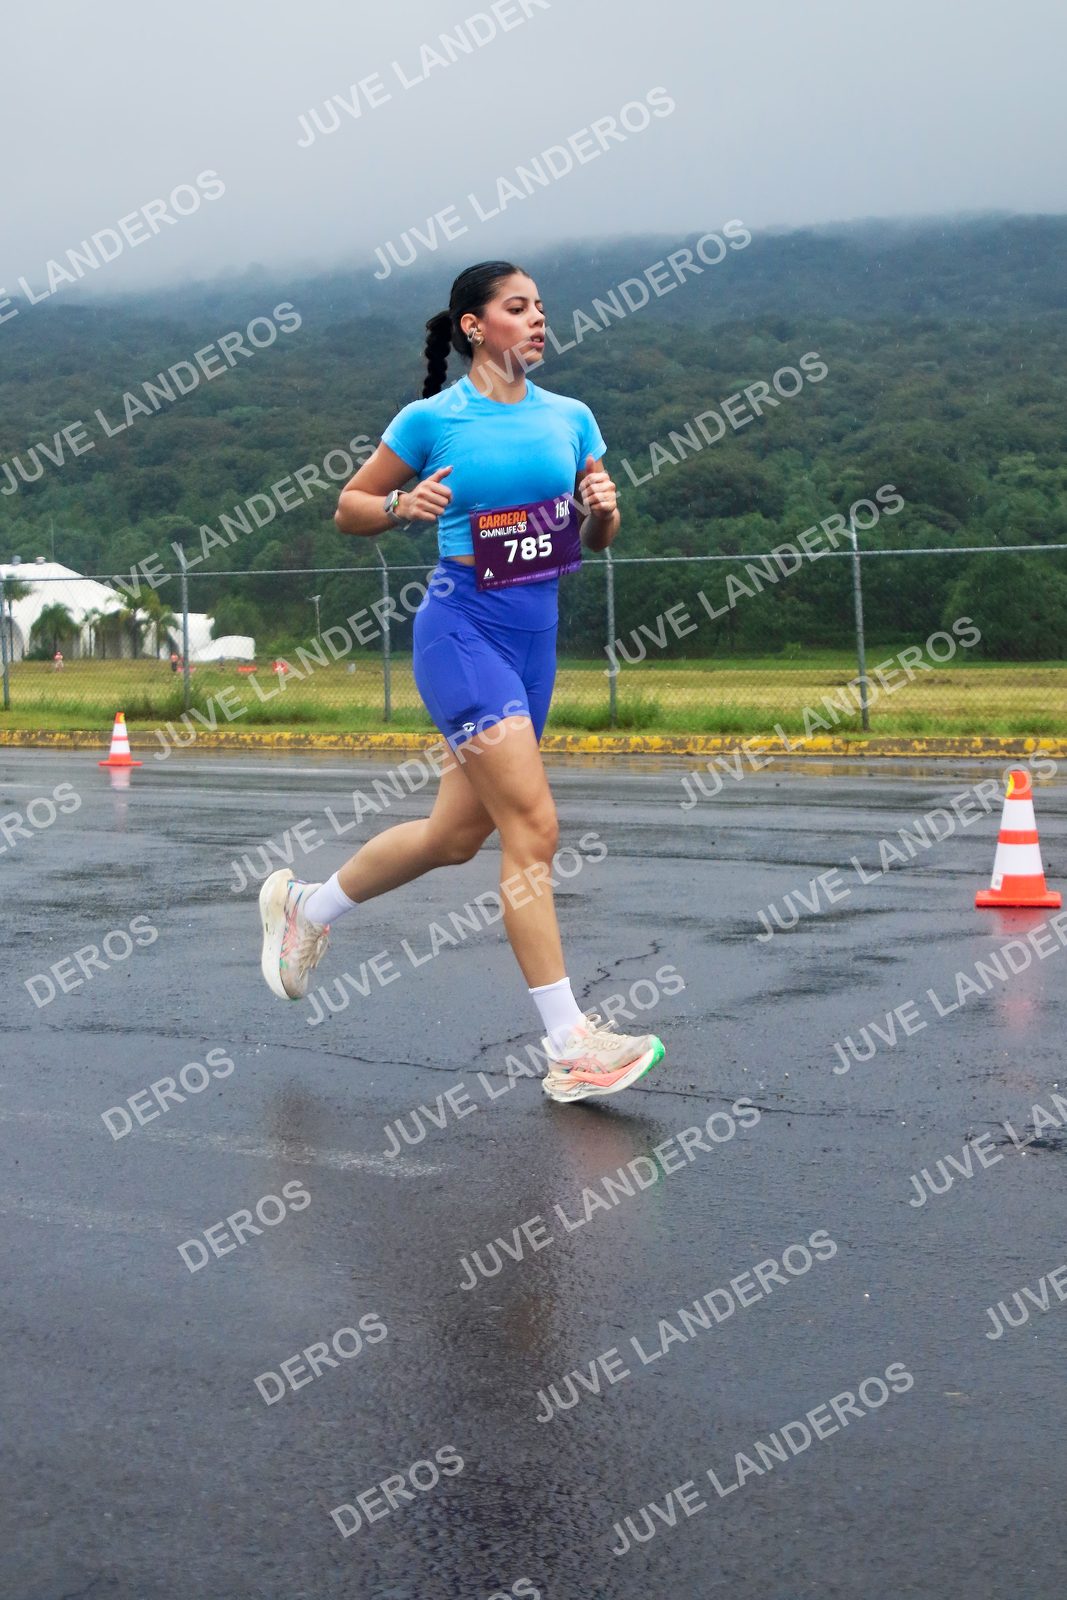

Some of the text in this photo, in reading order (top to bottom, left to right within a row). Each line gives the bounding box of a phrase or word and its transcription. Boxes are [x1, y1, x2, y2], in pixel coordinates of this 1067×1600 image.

[479, 510, 527, 529] CARRERA
[480, 524, 517, 538] OMNILIFE
[504, 534, 553, 563] 785
